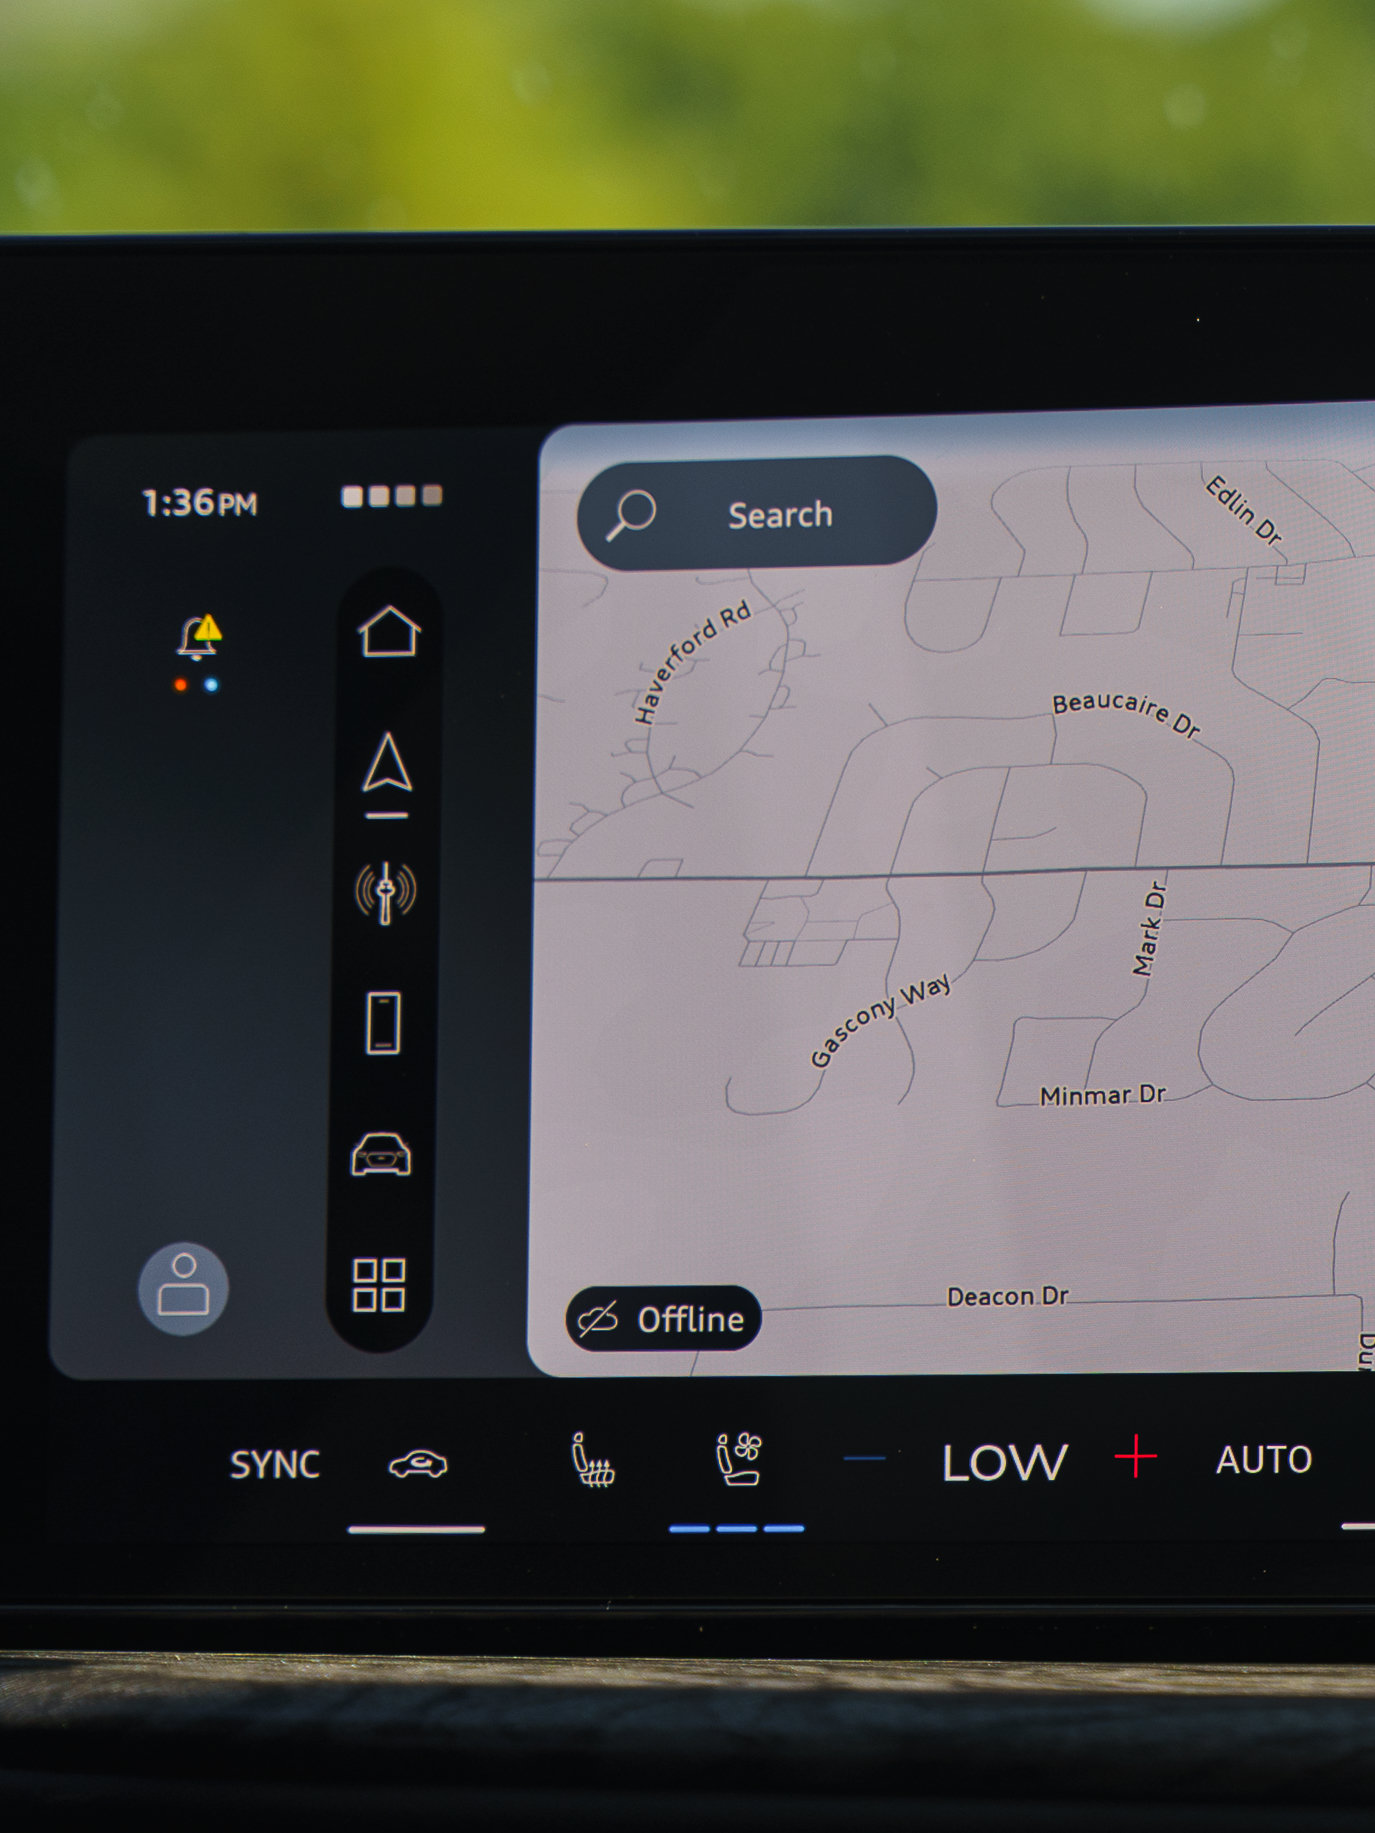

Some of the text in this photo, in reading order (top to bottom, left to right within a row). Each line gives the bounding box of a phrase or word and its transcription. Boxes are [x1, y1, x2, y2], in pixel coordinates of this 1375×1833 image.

[729, 499, 833, 529] Search
[1206, 475, 1282, 545] Edlin Dr
[635, 599, 751, 724] Haverford Rd
[1053, 694, 1200, 739] Beaucaire Dr
[1132, 881, 1166, 976] Mark Dr
[812, 974, 950, 1068] Gascony Way
[1041, 1084, 1166, 1106] Minmar Dr
[948, 1285, 1069, 1307] Deacon Dr
[638, 1305, 744, 1333] Offline
[231, 1449, 320, 1479] SYNC
[944, 1443, 1070, 1482] LOW
[1215, 1445, 1313, 1474] AUTO
